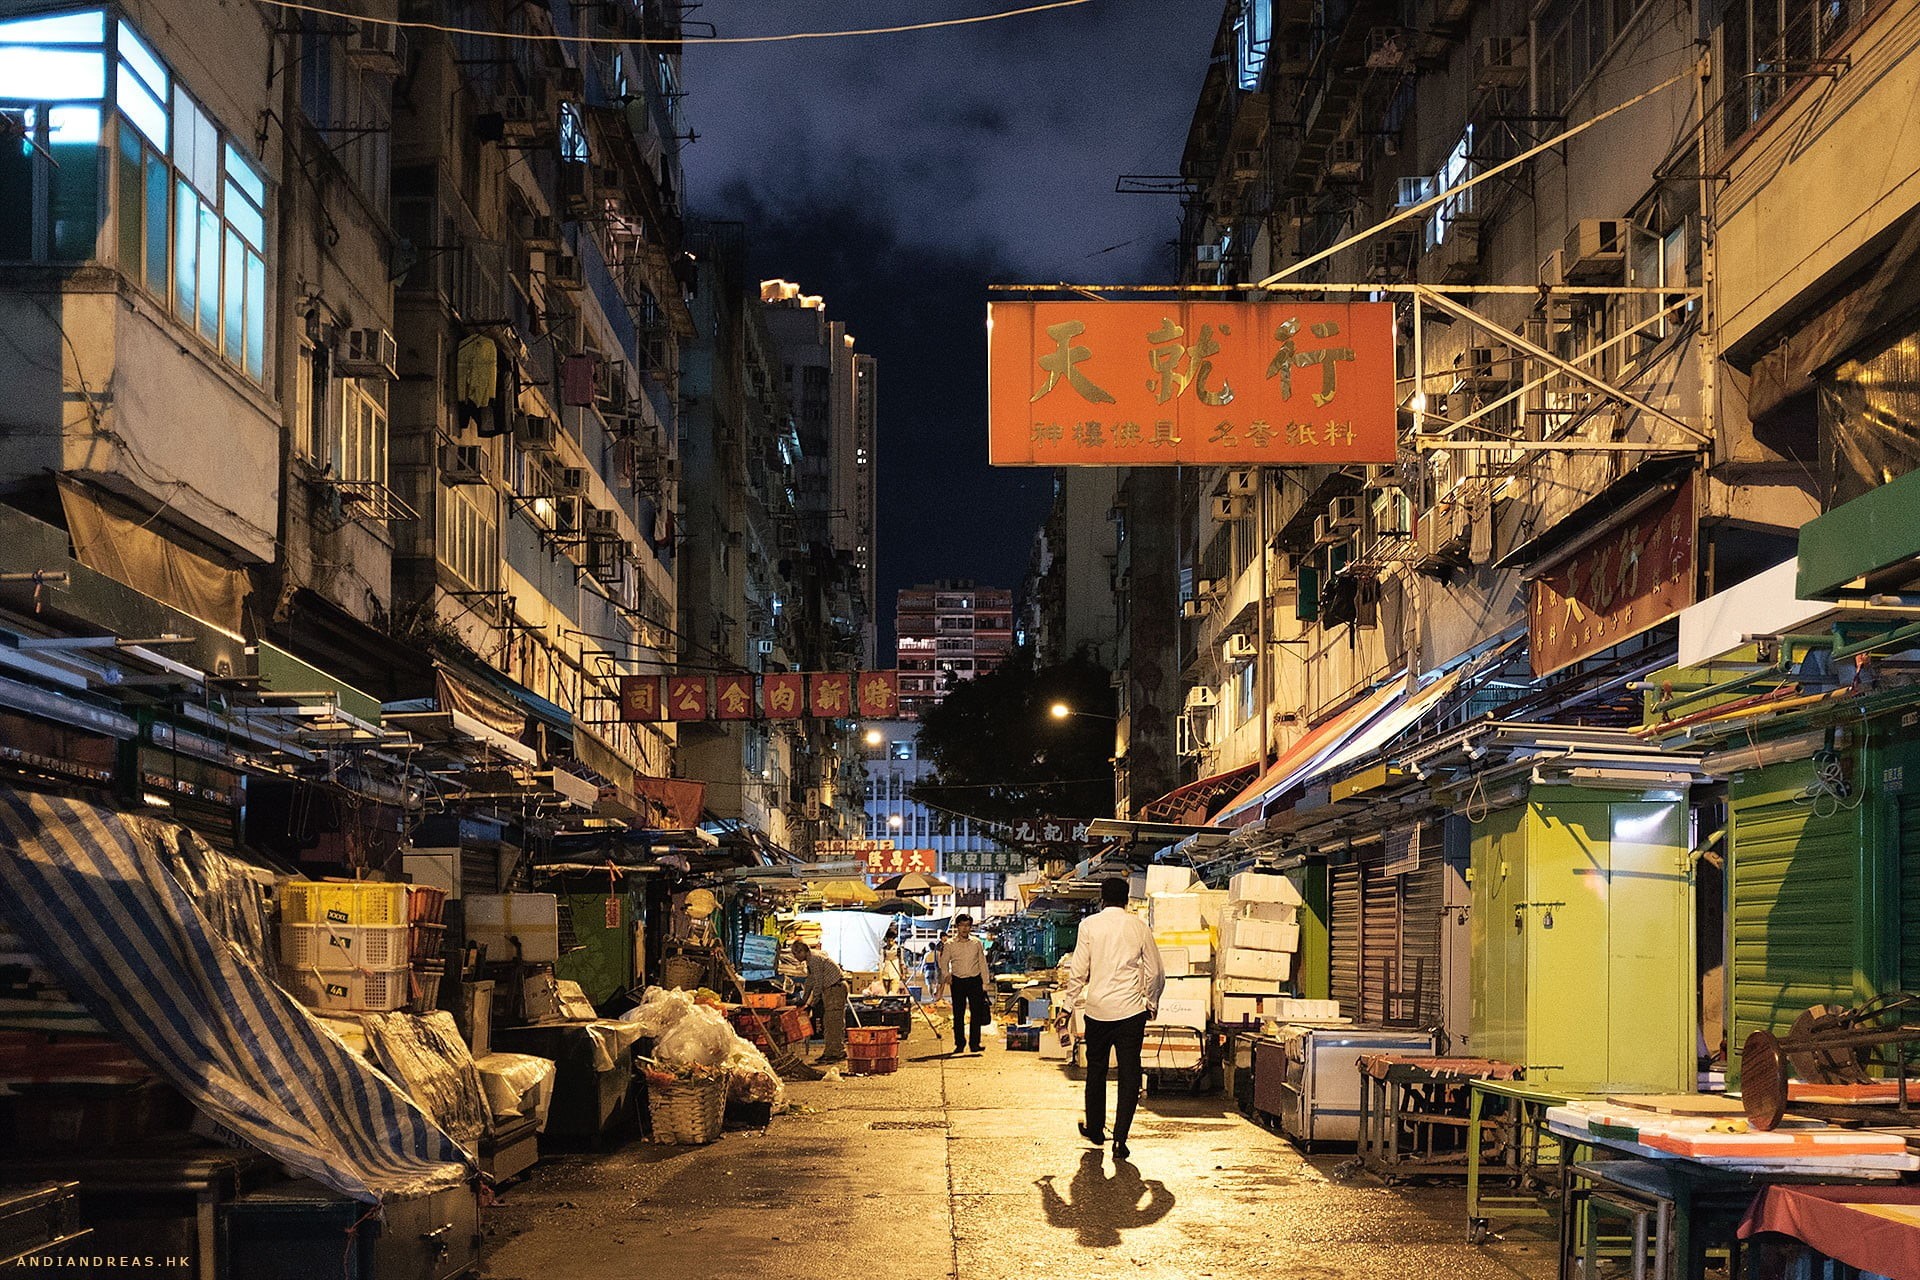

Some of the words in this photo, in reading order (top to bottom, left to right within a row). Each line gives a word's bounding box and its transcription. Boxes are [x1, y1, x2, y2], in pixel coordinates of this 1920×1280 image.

[1029, 316, 1356, 409] 天就行
[1208, 419, 1358, 449] 名香紙料
